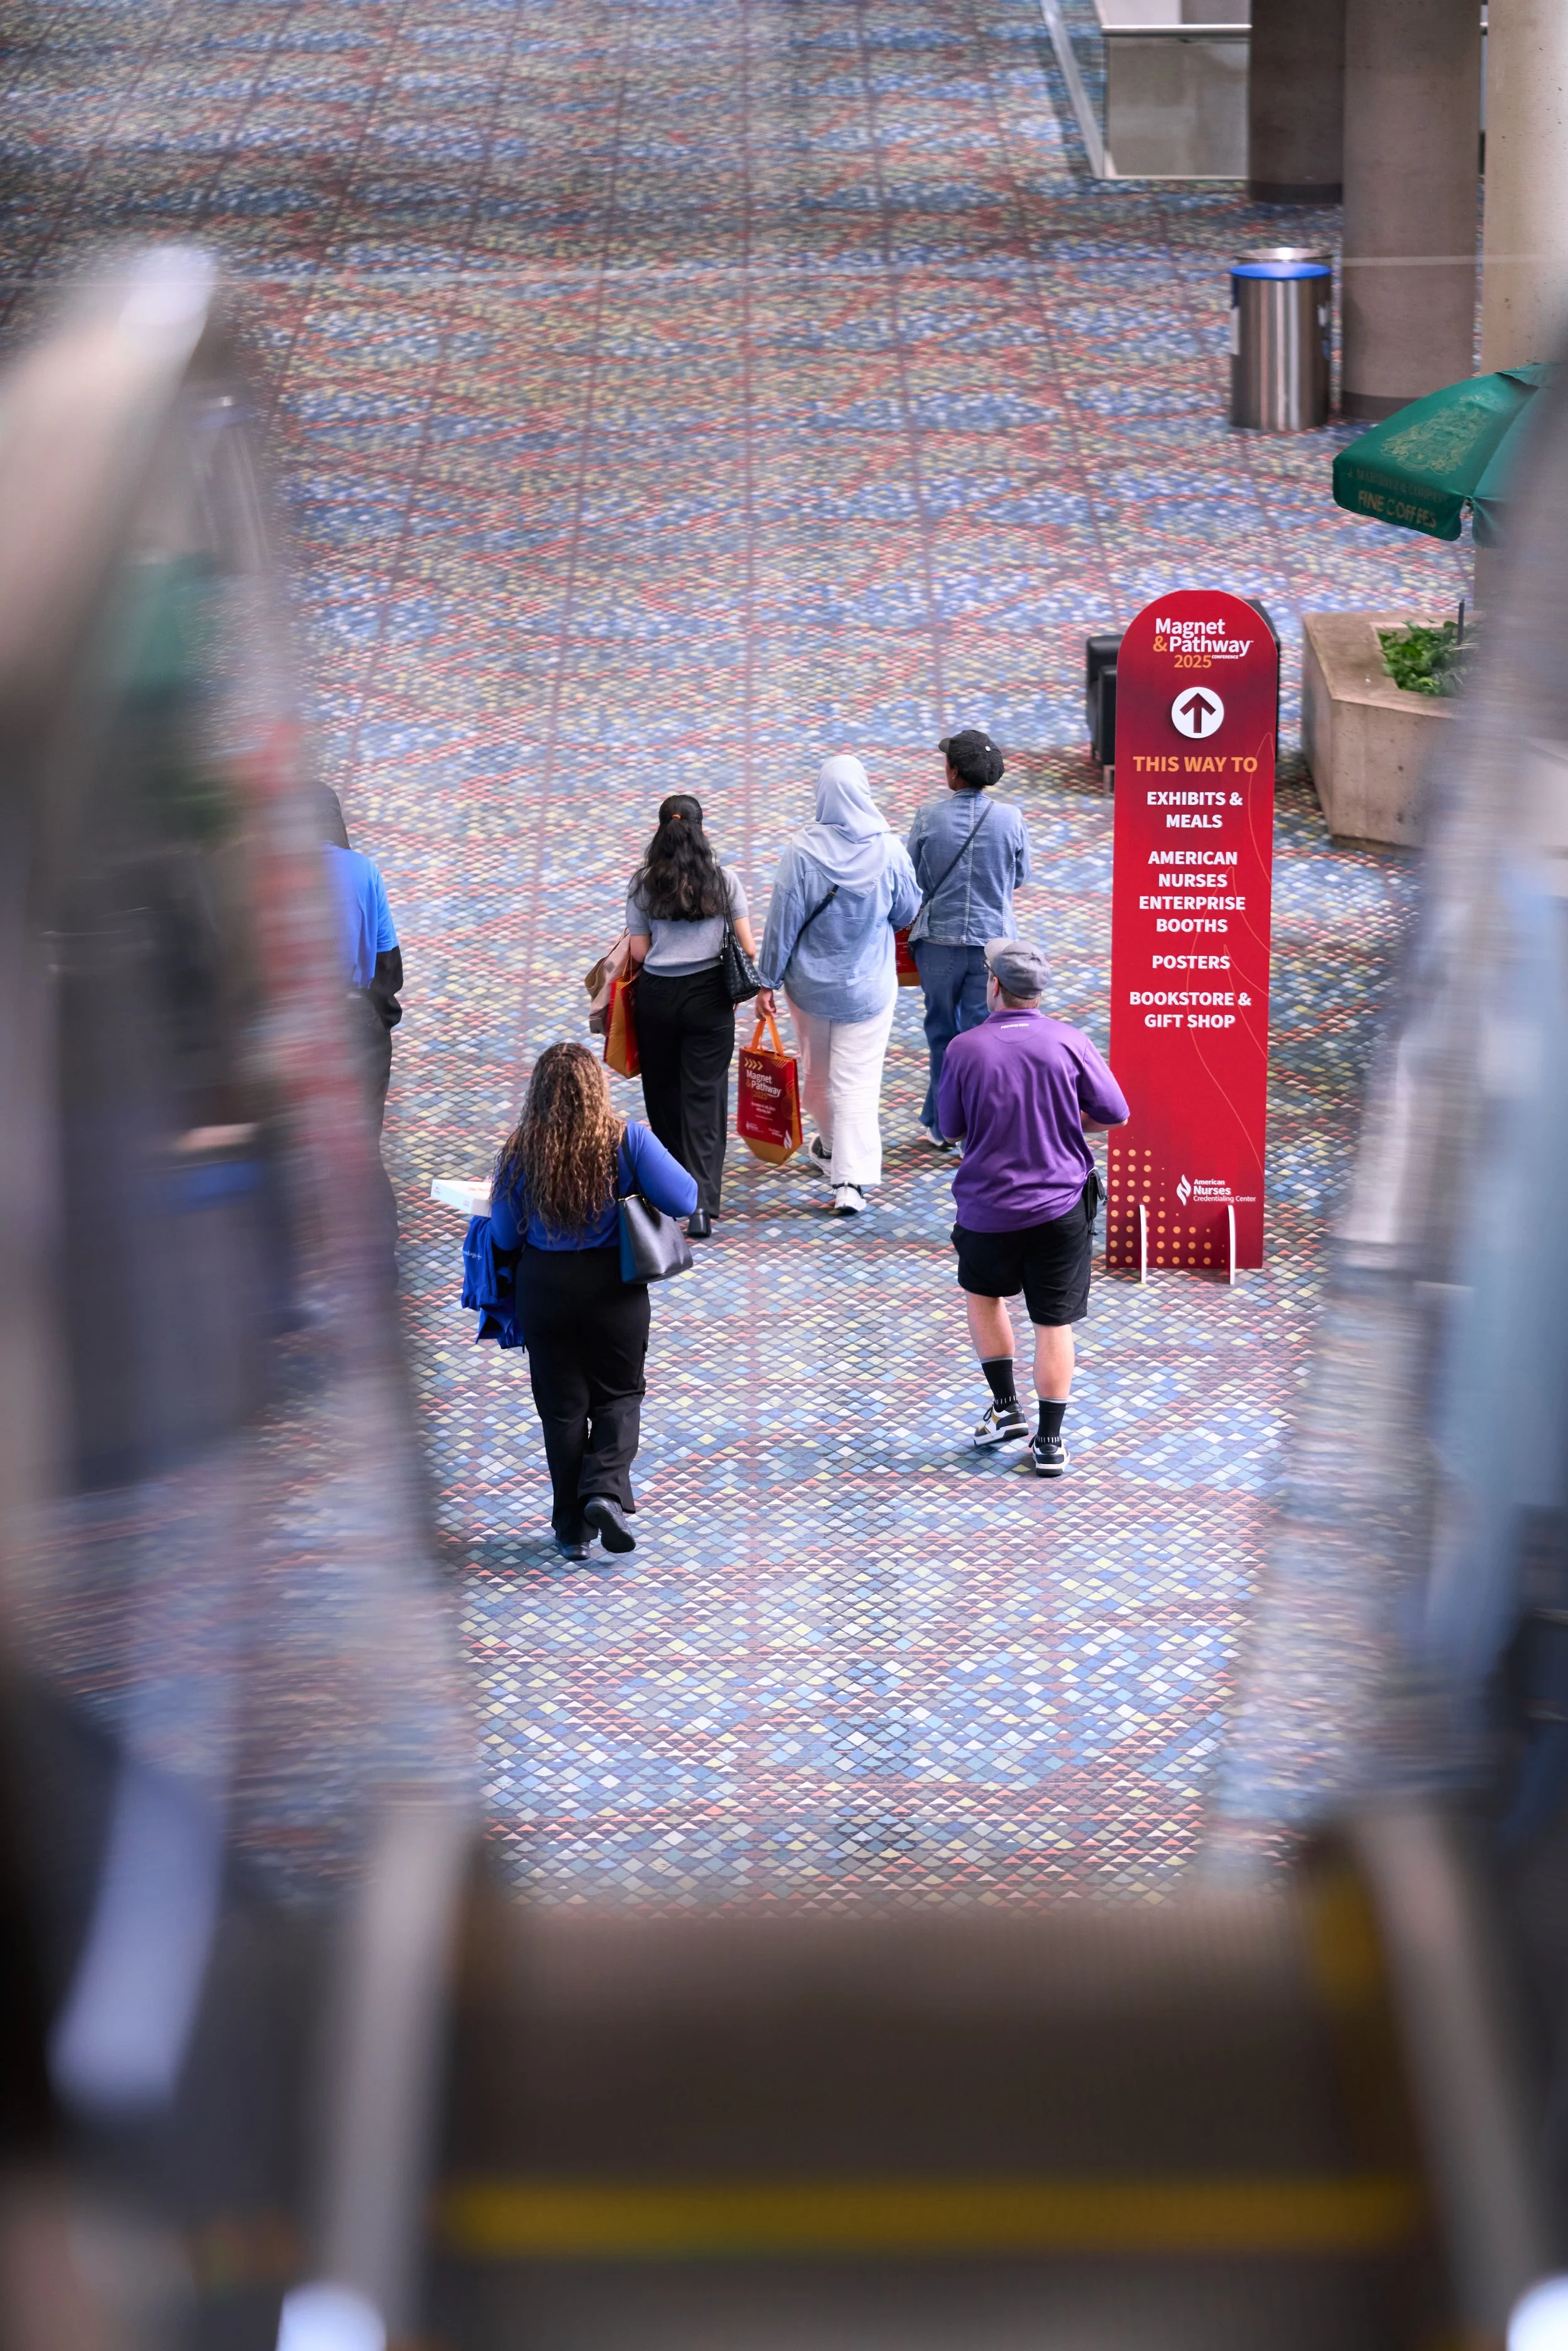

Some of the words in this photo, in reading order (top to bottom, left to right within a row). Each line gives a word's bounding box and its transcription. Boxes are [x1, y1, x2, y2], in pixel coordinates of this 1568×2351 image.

[1358, 490, 1385, 512] FINE
[1387, 499, 1437, 528] COFFEES
[1155, 618, 1226, 639] Magnet
[1173, 654, 1212, 668] 2025
[1133, 756, 1180, 772] THIS
[1184, 756, 1227, 772] WAY
[1231, 756, 1258, 772] TO
[1147, 791, 1226, 806] EXHIBITS
[1229, 792, 1243, 806] &
[1166, 814, 1223, 829] MEALS
[1148, 851, 1238, 865] AMERICAN
[1158, 873, 1228, 888] NURSES
[1139, 896, 1246, 911] ENTERPRISE
[1156, 918, 1229, 933] BOOTHS
[1152, 955, 1231, 970] POSTERS
[1130, 991, 1235, 1006] BOOKSTORE
[1237, 992, 1253, 1006] &
[1144, 1014, 1184, 1028] GIFT
[1187, 1014, 1236, 1029] SHOP
[746, 1069, 772, 1084] Magnet
[1193, 1185, 1231, 1196] Nurses
[1193, 1195, 1234, 1203] Credentialing
